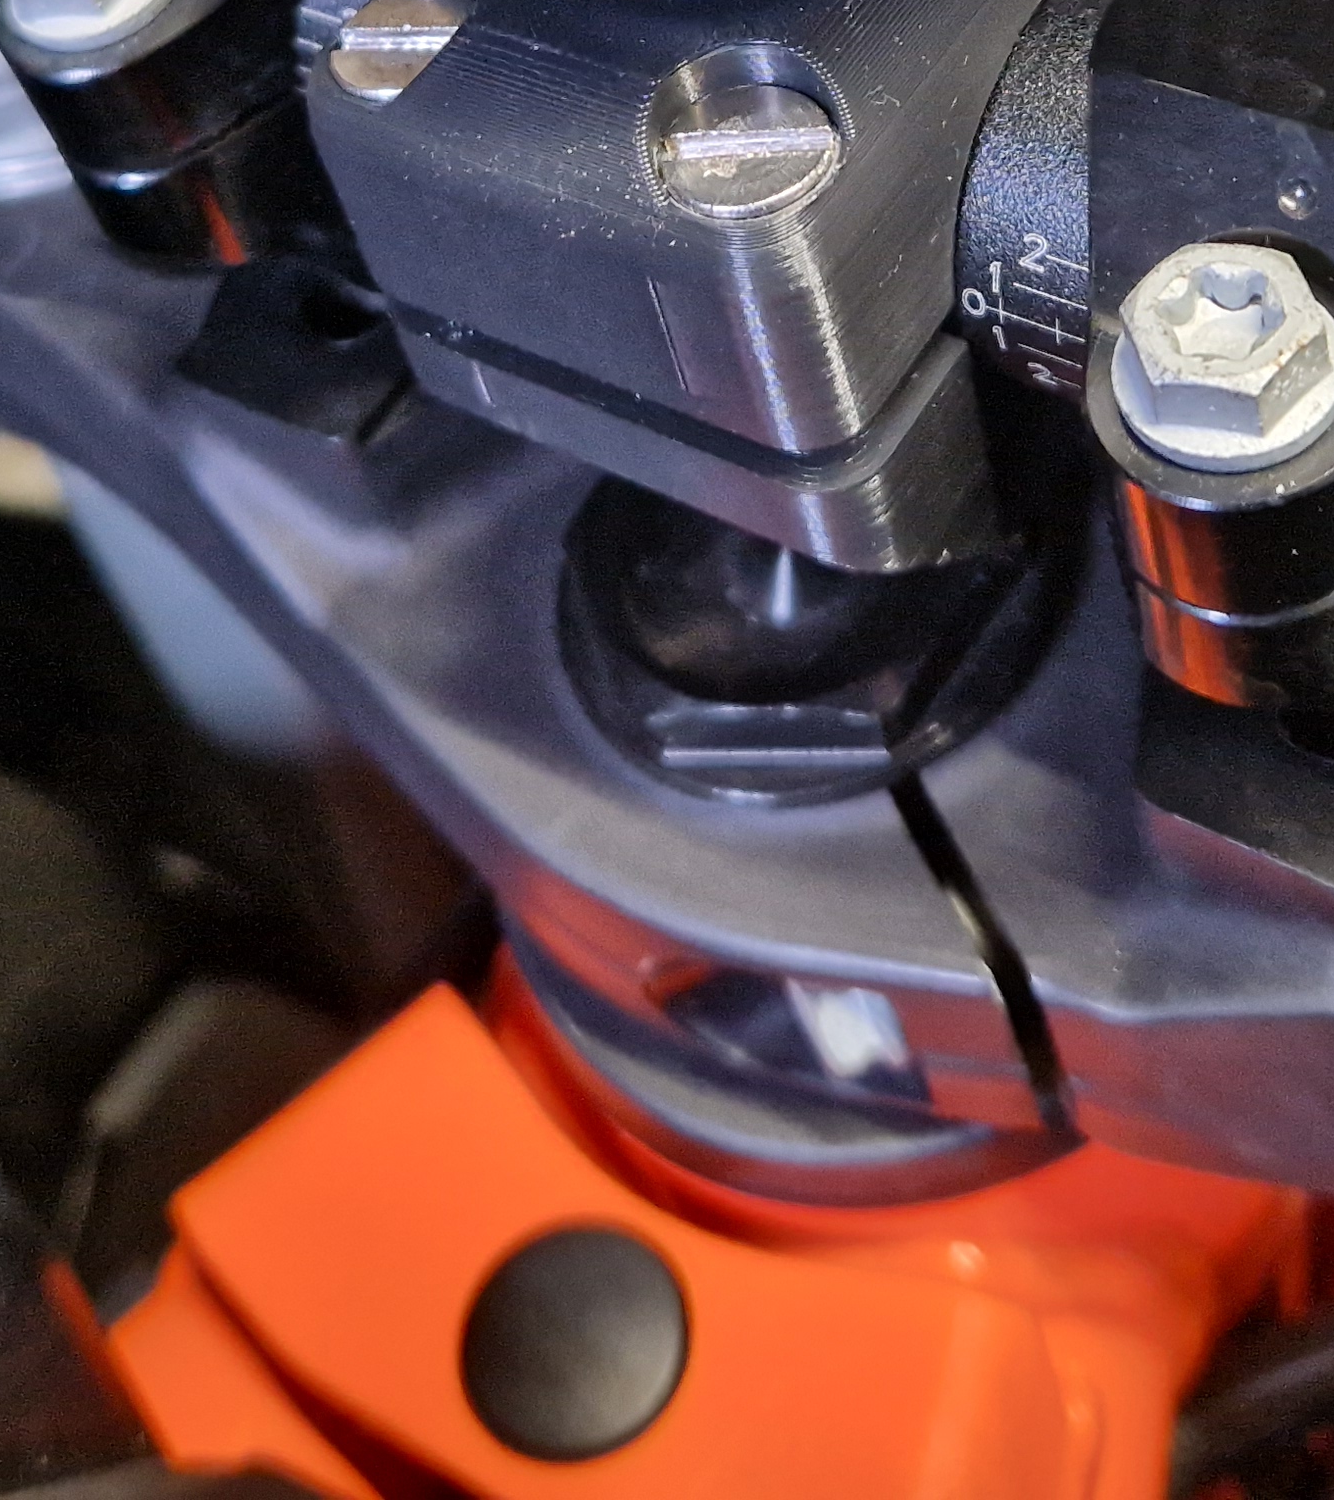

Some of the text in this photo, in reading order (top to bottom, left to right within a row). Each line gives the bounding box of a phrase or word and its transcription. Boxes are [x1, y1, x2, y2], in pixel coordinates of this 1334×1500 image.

[1019, 232, 1048, 274] 2
[989, 260, 1003, 294] 1
[961, 287, 987, 318] 0
[992, 325, 1008, 351] 1
[1027, 361, 1059, 386] 2
